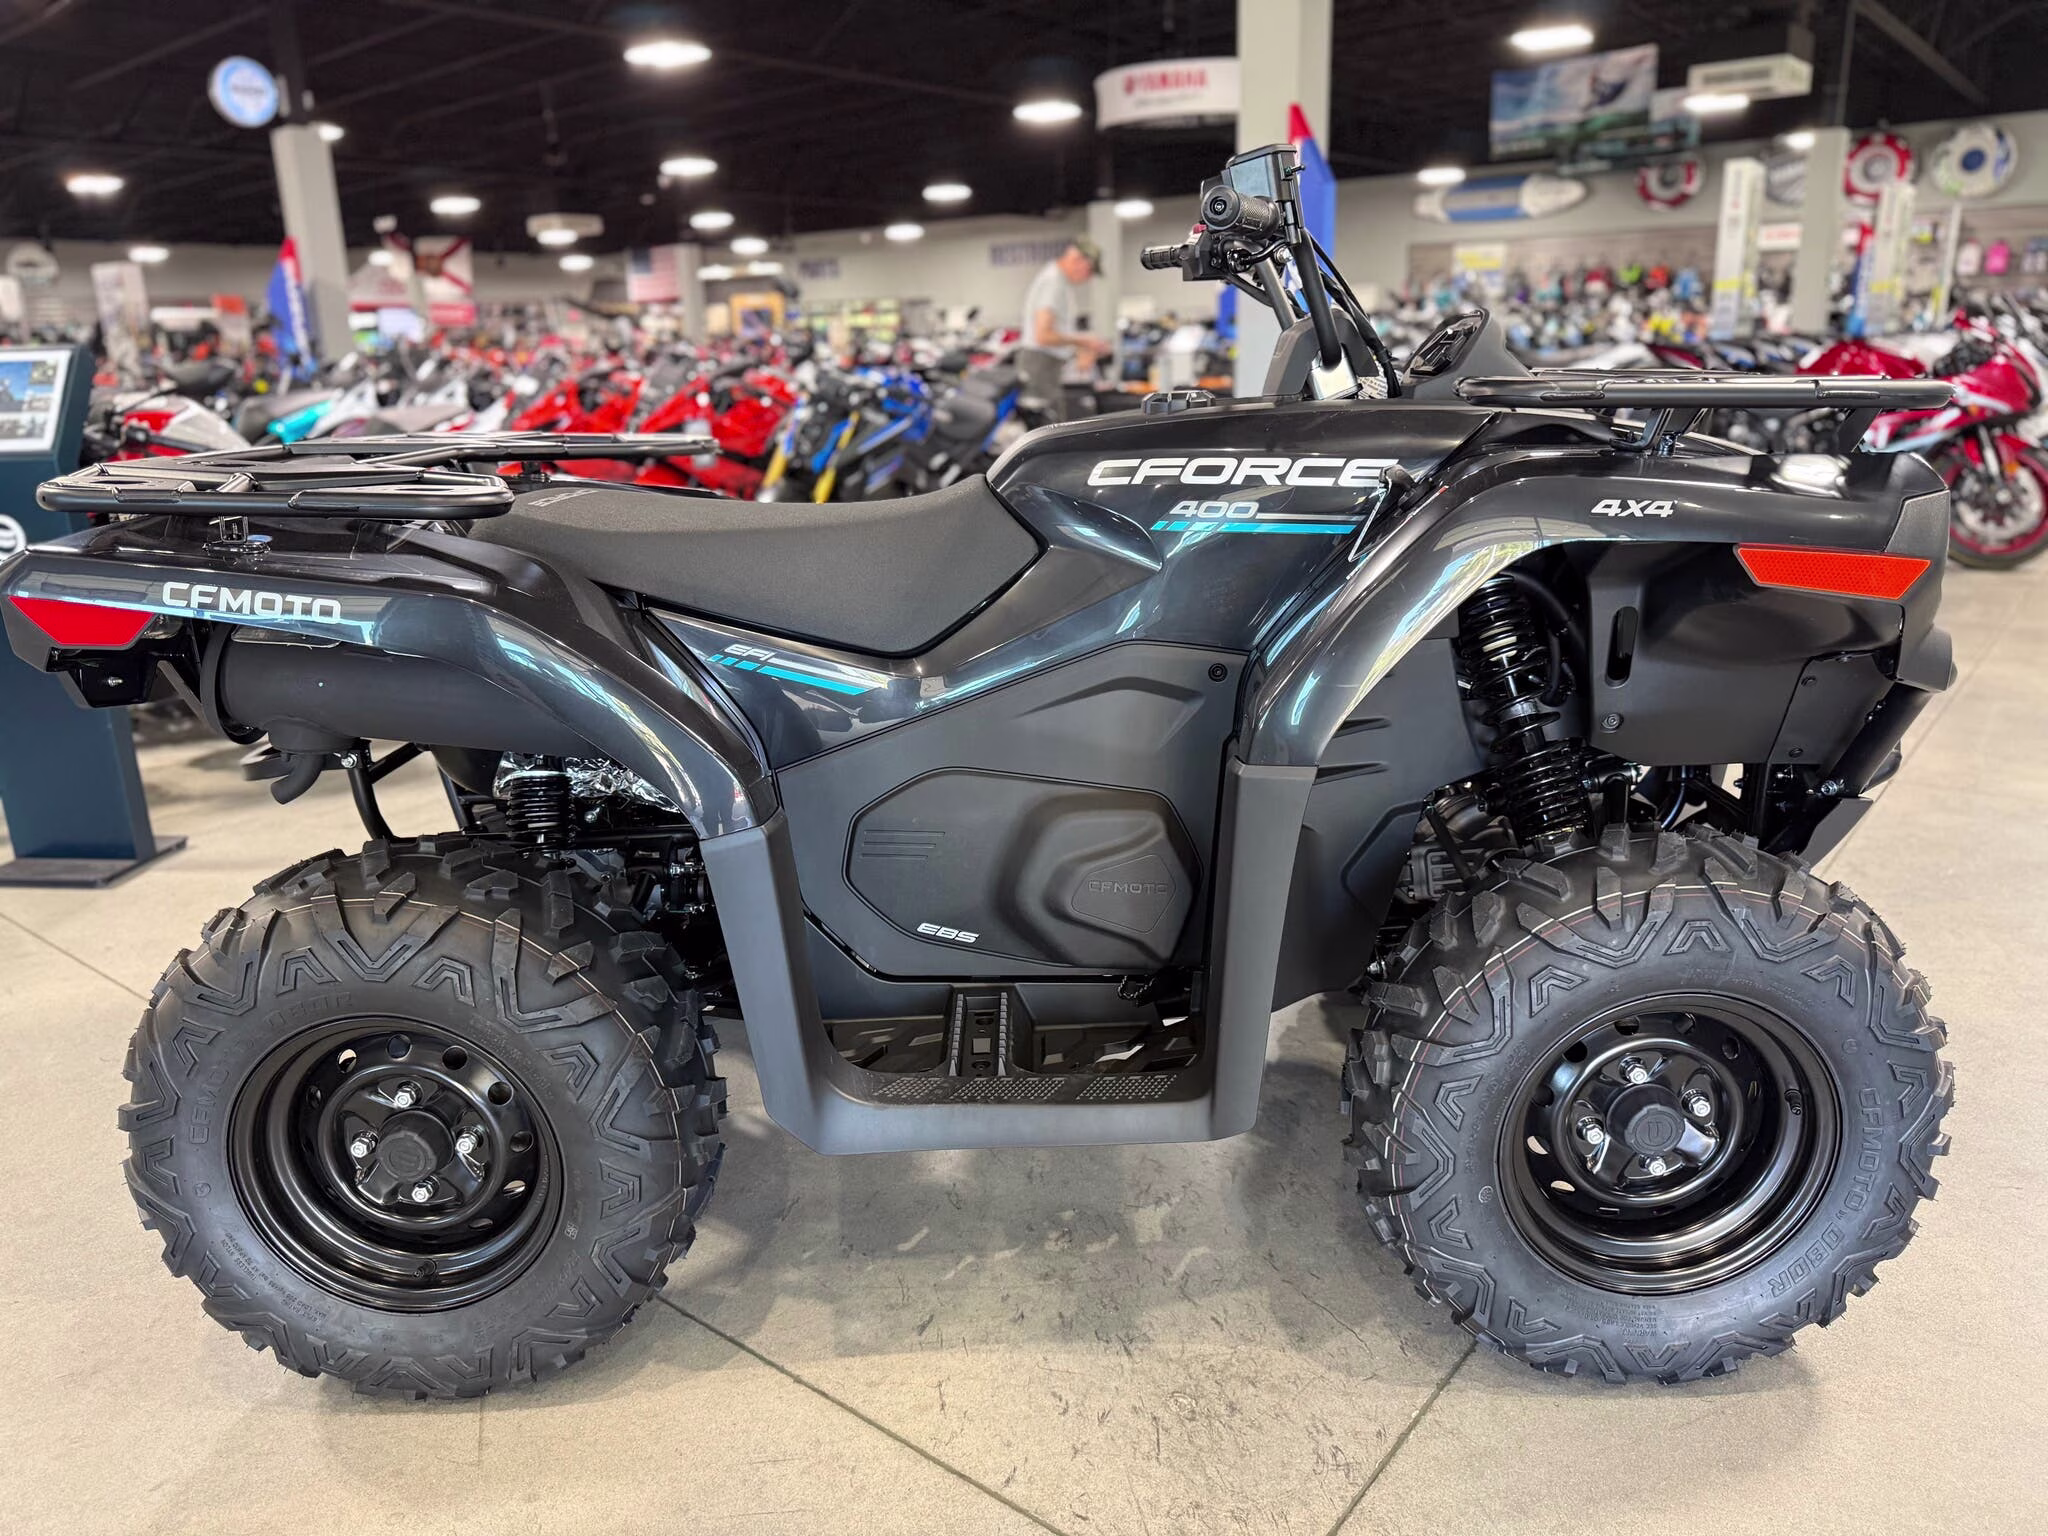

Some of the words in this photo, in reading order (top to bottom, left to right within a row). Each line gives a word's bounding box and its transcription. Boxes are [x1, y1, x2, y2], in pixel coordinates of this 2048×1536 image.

[1087, 457, 1399, 487] CFORCE
[1169, 500, 1258, 519] 400
[162, 581, 342, 625] CFMOTO
[724, 643, 776, 661] EFI
[1088, 879, 1168, 895] CFMOTO
[916, 922, 980, 944] EBS
[1846, 1087, 1884, 1212] CFMOTO
